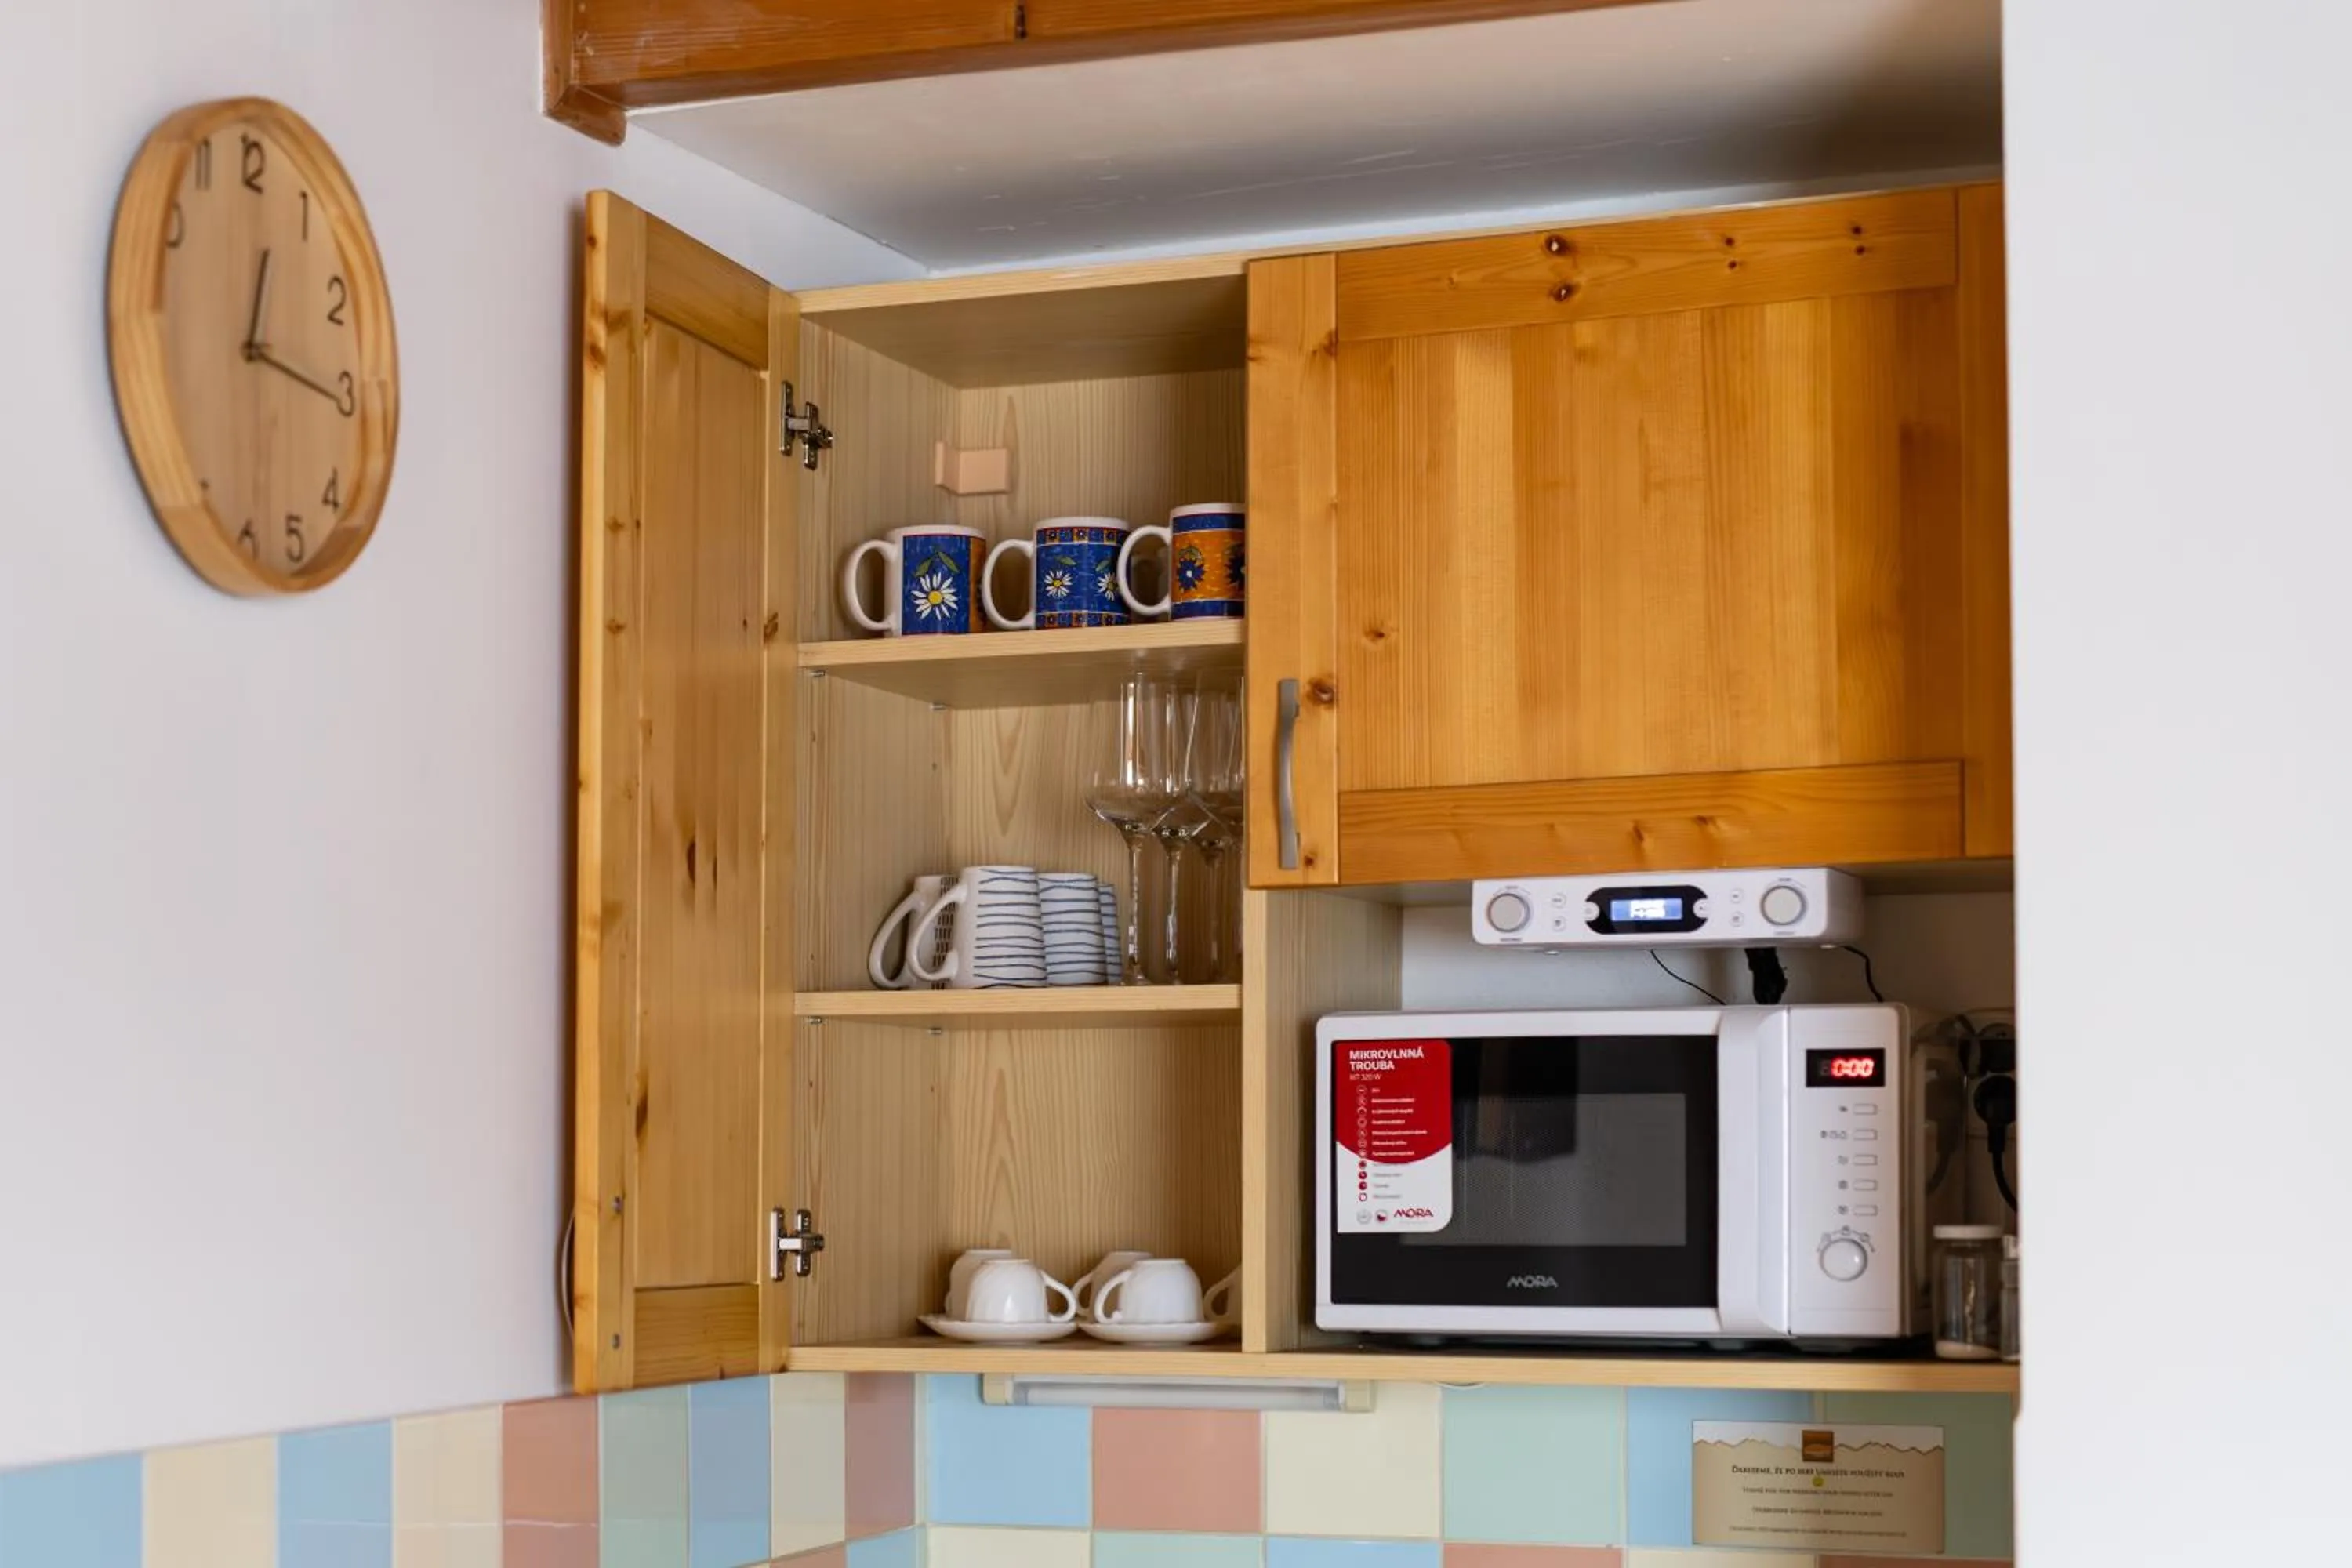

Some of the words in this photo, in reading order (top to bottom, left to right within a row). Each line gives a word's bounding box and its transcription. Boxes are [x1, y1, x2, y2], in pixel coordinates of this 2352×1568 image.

[194, 136, 212, 191] 11
[240, 132, 266, 194] 12
[299, 190, 309, 242] 1
[327, 275, 347, 326] 2
[335, 370, 356, 417] 3
[322, 468, 340, 513] 4
[285, 514, 305, 564] 5
[1349, 1045, 1425, 1060] MIKROVLNNÁ
[1349, 1060, 1396, 1072] TROUBA
[1393, 1208, 1434, 1218] MORA
[1506, 1275, 1559, 1288] MORA
